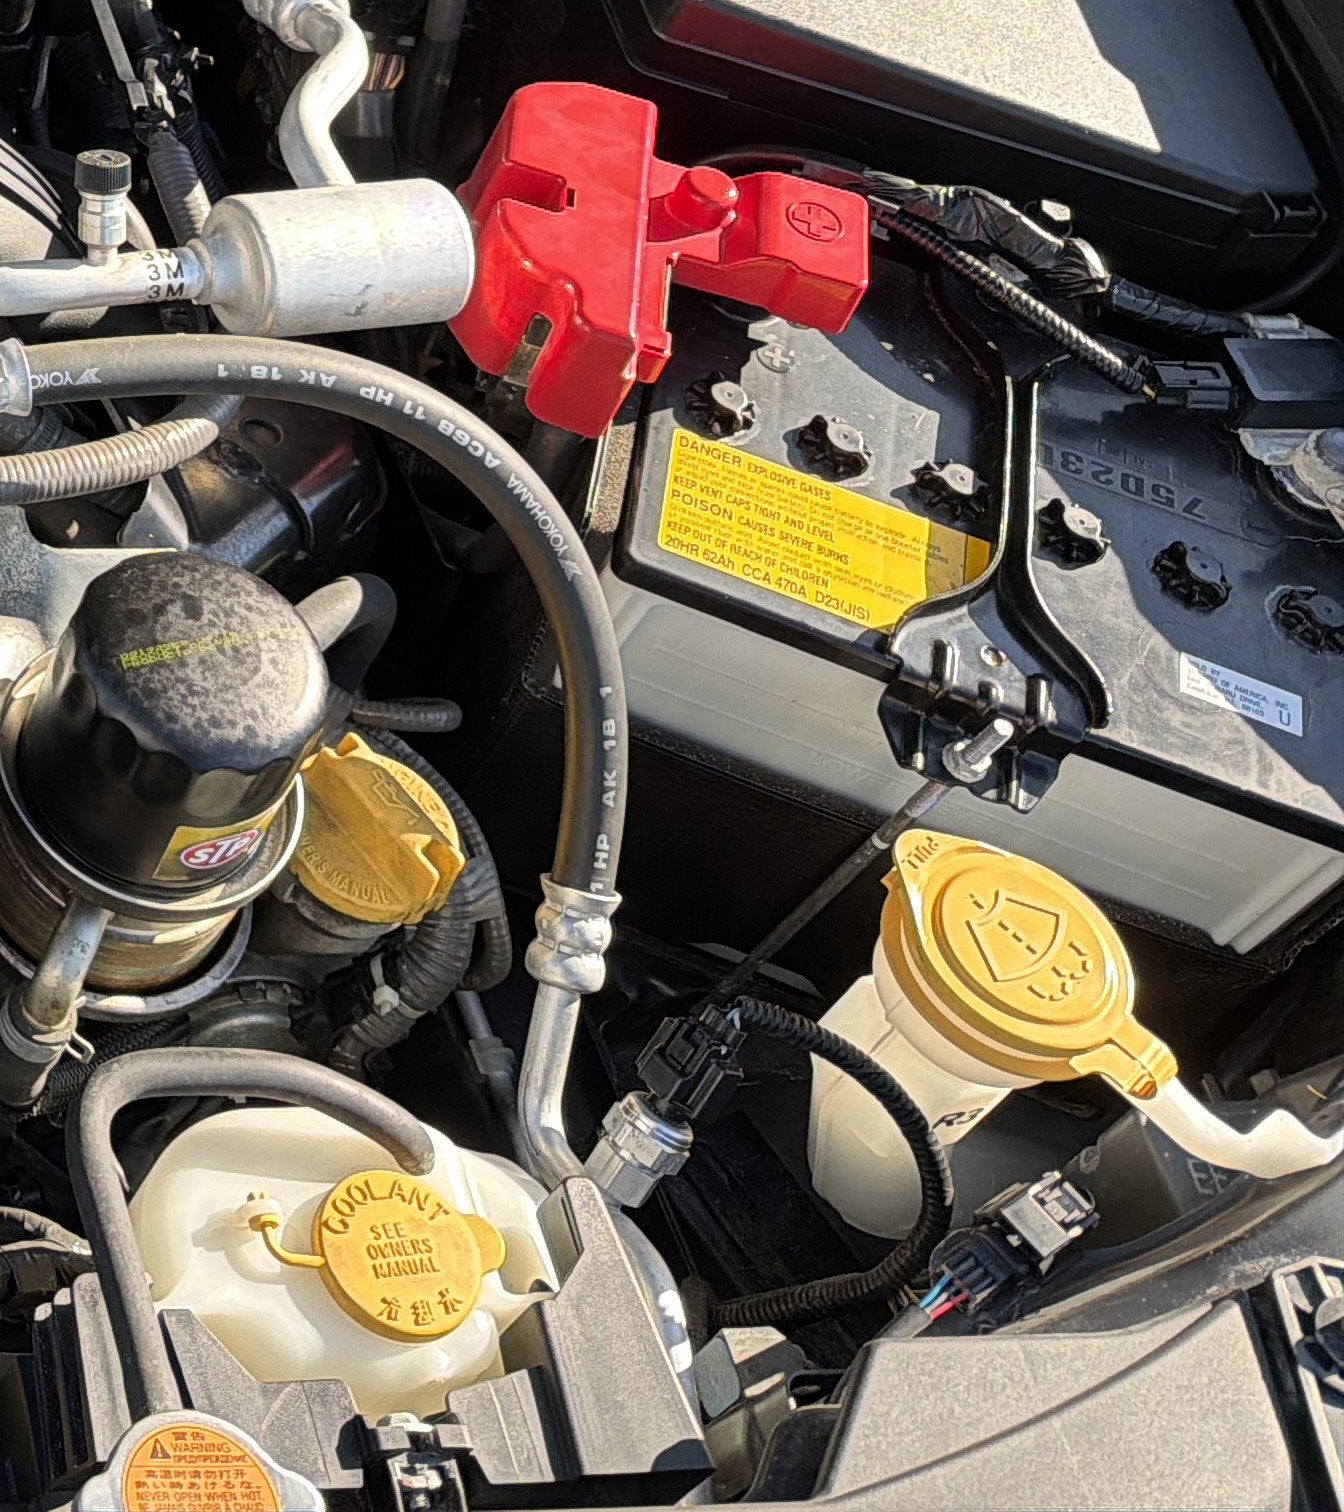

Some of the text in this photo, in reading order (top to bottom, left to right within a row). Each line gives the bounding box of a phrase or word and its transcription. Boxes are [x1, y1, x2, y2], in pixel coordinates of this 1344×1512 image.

[147, 262, 185, 281] 3 M
[147, 282, 185, 299] 3 M
[298, 368, 338, 389] AK
[360, 386, 394, 407] HP
[402, 399, 426, 422] 11
[680, 435, 742, 468] DANGER
[800, 481, 832, 501] GASES
[507, 472, 569, 557] YOKOHAMA
[674, 474, 836, 543] KEEP VENT CAPS TIGHT AND LEVEL
[672, 489, 850, 566] POISON CAUSES SEVERE BURNS
[668, 520, 829, 589] KEEP OUT OF REACH OF CHILDREN
[665, 534, 871, 622] 20HR 62Ah CCA 470A D23(JIS)
[1211, 667, 1221, 677] BY
[1221, 678, 1230, 688] OF
[1279, 709, 1291, 726] U
[593, 833, 610, 870] HP
[602, 769, 617, 807] AK
[189, 836, 251, 864] STP
[328, 869, 391, 904] MANUAL
[930, 1107, 985, 1130] R3
[321, 1179, 451, 1235] COOLANT
[369, 1221, 408, 1241] SEE
[366, 1237, 434, 1261] OWNERS
[371, 1256, 441, 1280] MANUAL
[170, 1442, 232, 1454] WARNING
[136, 1491, 171, 1502] NEVER
[174, 1491, 202, 1502] OPEN
[206, 1490, 237, 1502] WHEN
